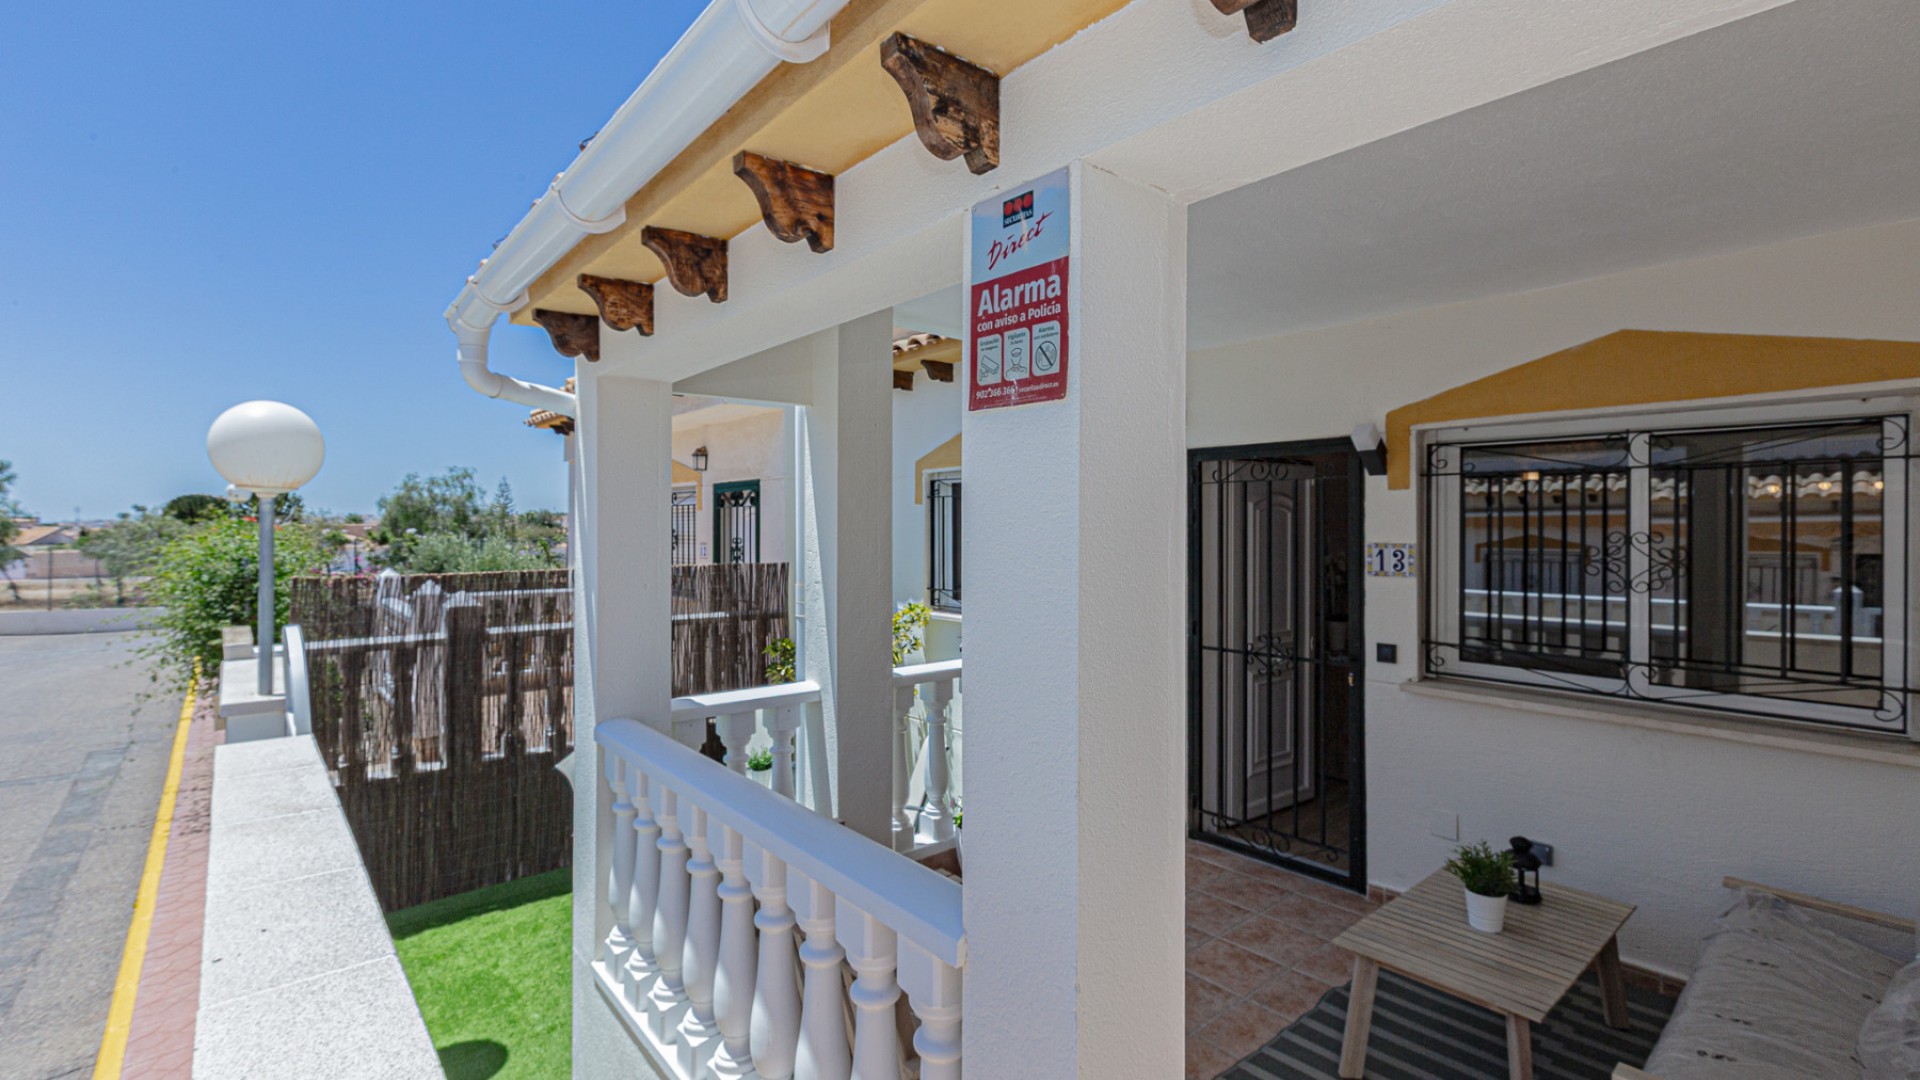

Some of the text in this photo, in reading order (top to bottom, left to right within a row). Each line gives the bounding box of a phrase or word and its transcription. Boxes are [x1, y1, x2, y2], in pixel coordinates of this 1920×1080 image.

[987, 210, 1054, 270] Direct
[978, 274, 1061, 317] Alarma
[977, 301, 1061, 332] con aviso a Policía
[1376, 549, 1405, 572] 13
